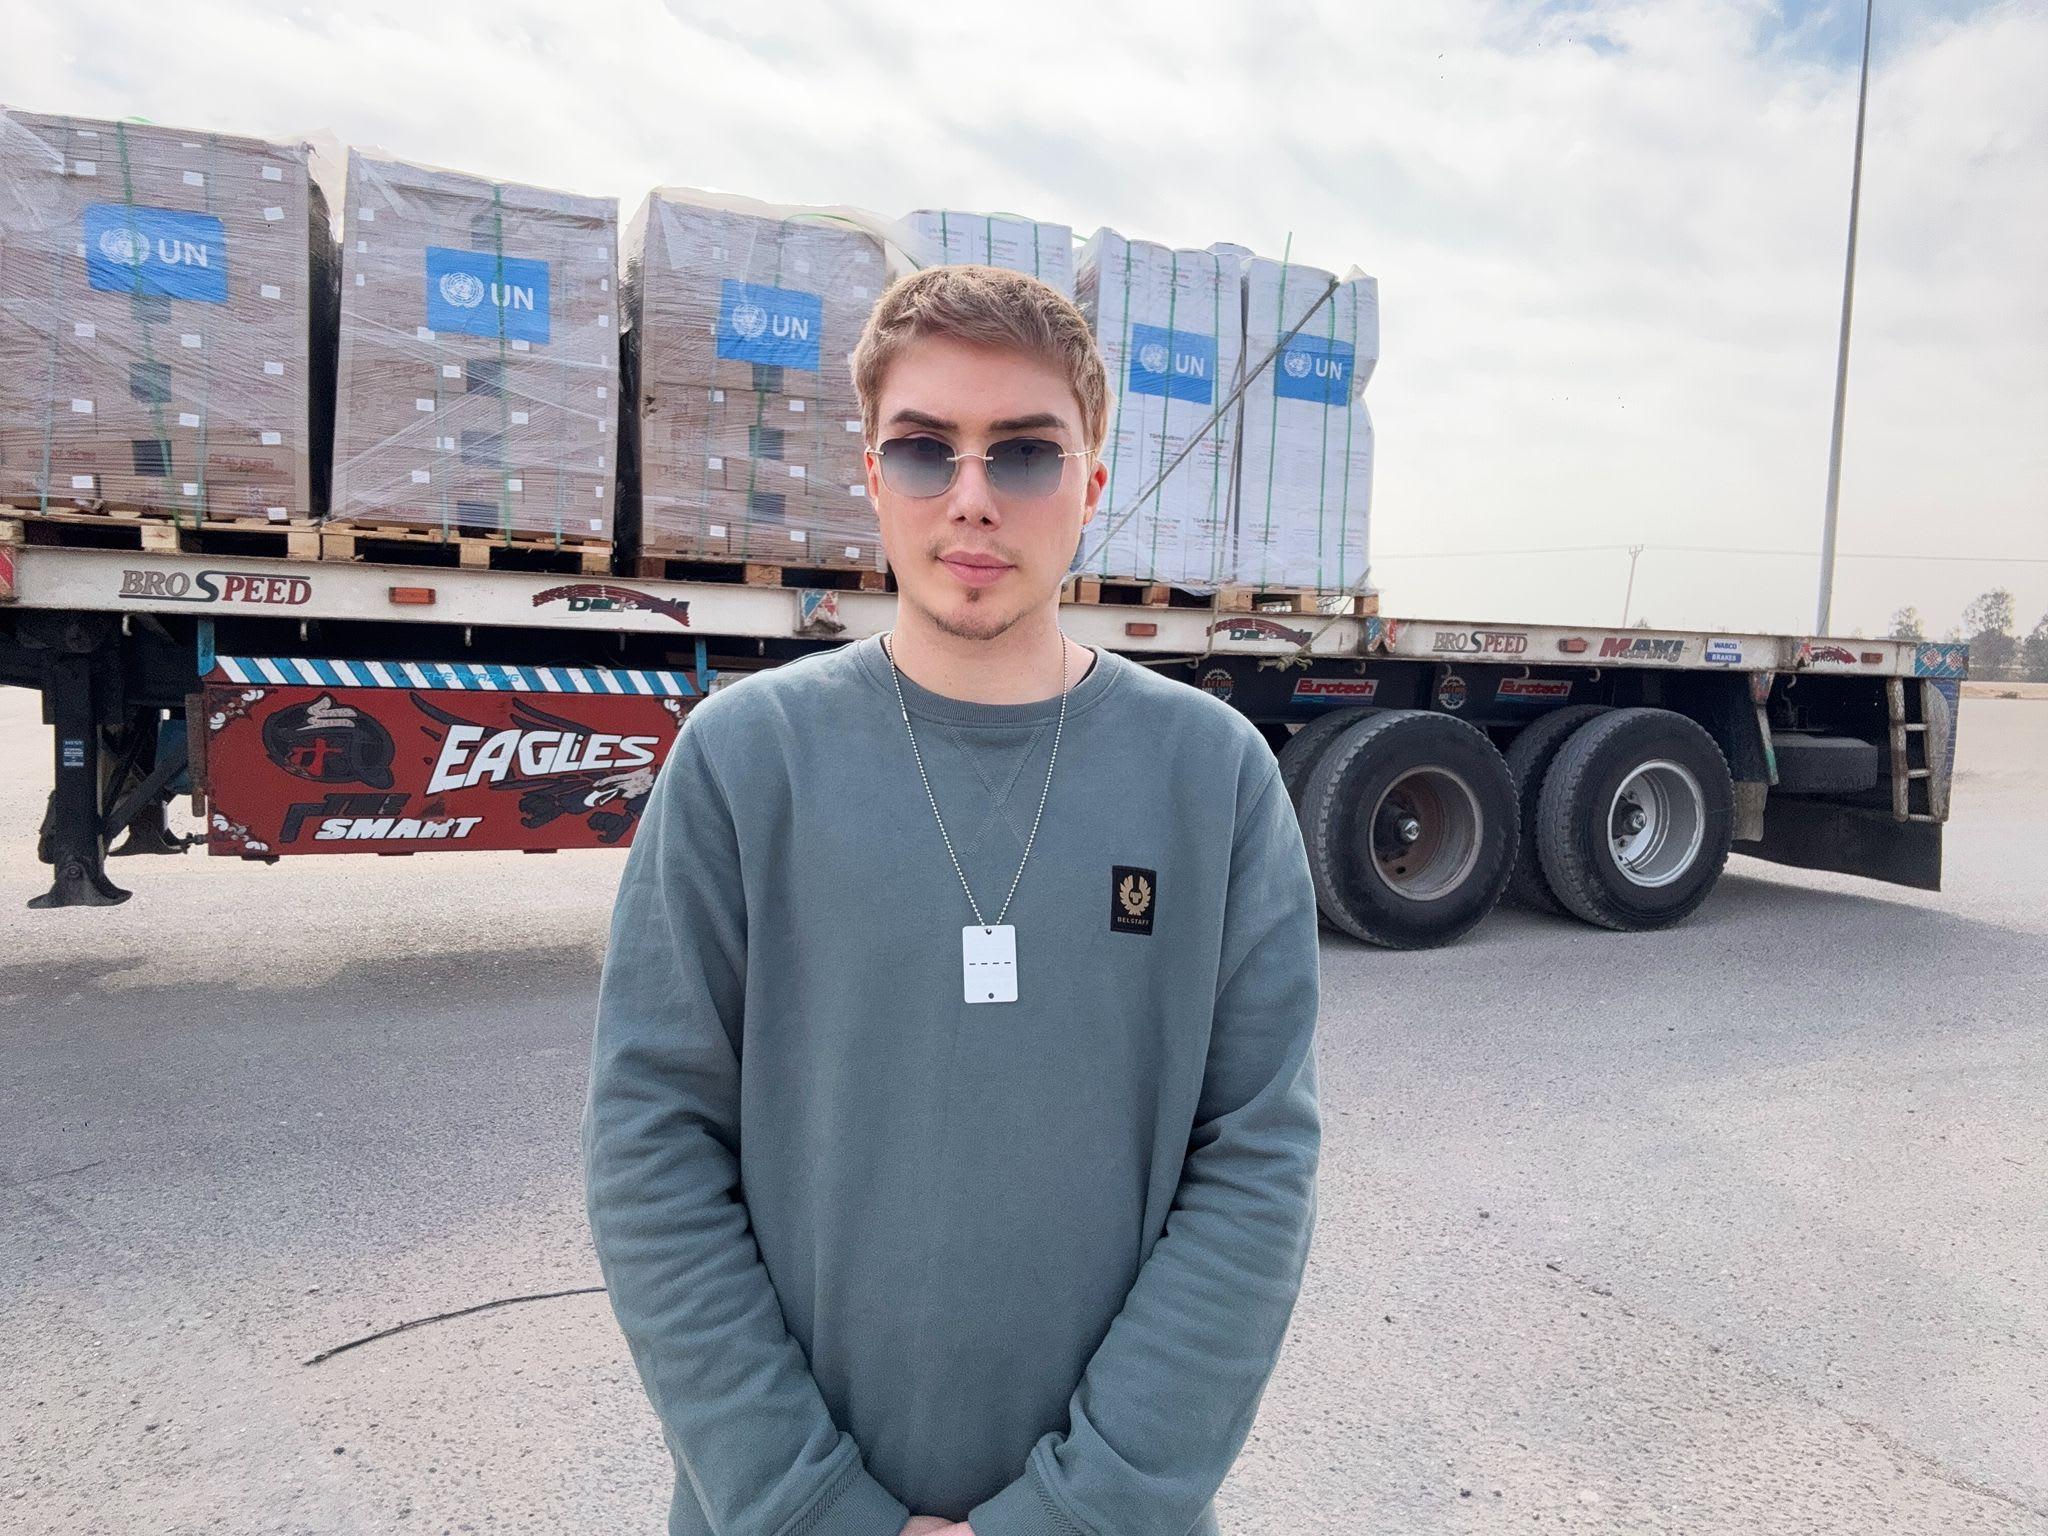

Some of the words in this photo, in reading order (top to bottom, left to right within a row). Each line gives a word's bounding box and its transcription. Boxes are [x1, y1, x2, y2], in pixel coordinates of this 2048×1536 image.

[158, 238, 208, 267] UN
[490, 282, 534, 311] UN
[772, 314, 809, 340] UN
[1175, 353, 1204, 377] UN
[1315, 358, 1343, 380] UN
[1711, 653, 1737, 661] BRAKES
[1714, 642, 1738, 650] WABCO
